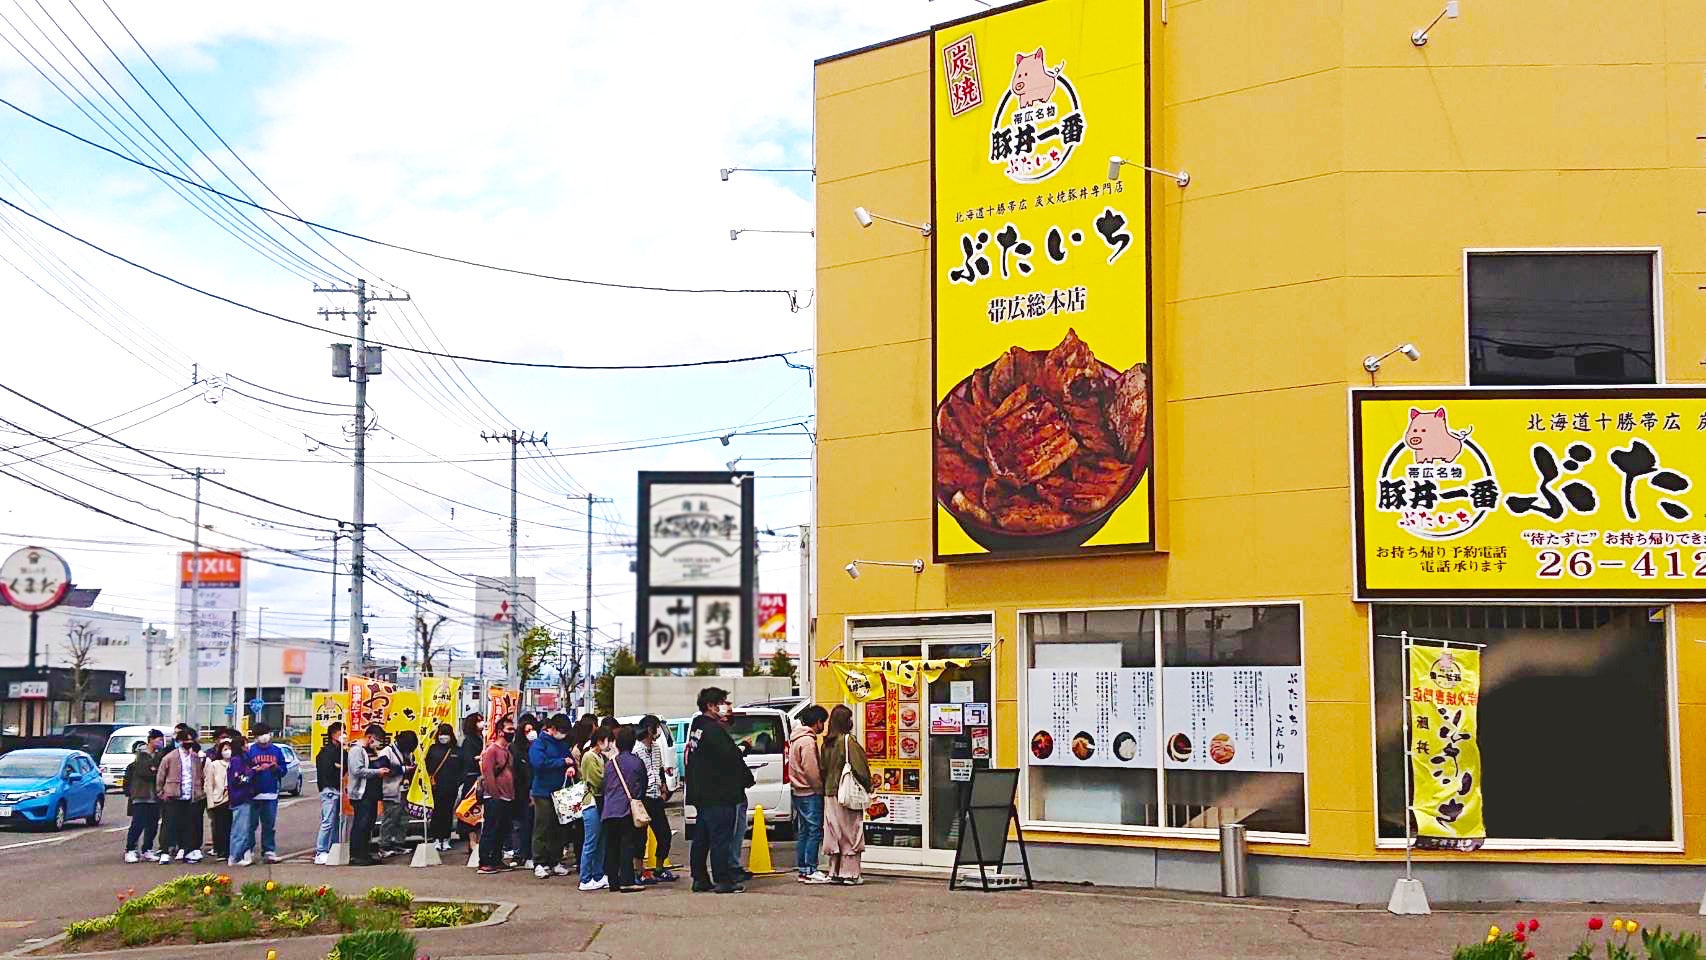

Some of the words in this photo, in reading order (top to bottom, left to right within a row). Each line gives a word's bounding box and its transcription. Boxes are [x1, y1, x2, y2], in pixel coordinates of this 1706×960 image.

[951, 45, 978, 111] 炭焼
[1013, 105, 1056, 125] 帯広名物
[990, 113, 1084, 161] 豚丼一番
[1006, 149, 1060, 175] ぶたいち
[950, 209, 1131, 282] ぶたいち
[987, 286, 1086, 323] 帯広総本店
[1526, 412, 1681, 432] 北海道十勝帯広
[1408, 467, 1462, 478] 帯広名物
[1505, 440, 1690, 519] ぶた
[1378, 479, 1499, 509] 豚丼一番
[1399, 511, 1470, 527] ぶたいち
[1605, 532, 1706, 545] お持ち帰りでき
[187, 558, 235, 573] LIXIL
[1420, 560, 1508, 573] 電話承ります
[9, 577, 57, 595] くまだ
[704, 601, 731, 651] 寿司
[1286, 672, 1299, 737] ぶたいちの
[1275, 713, 1286, 766] こだわり
